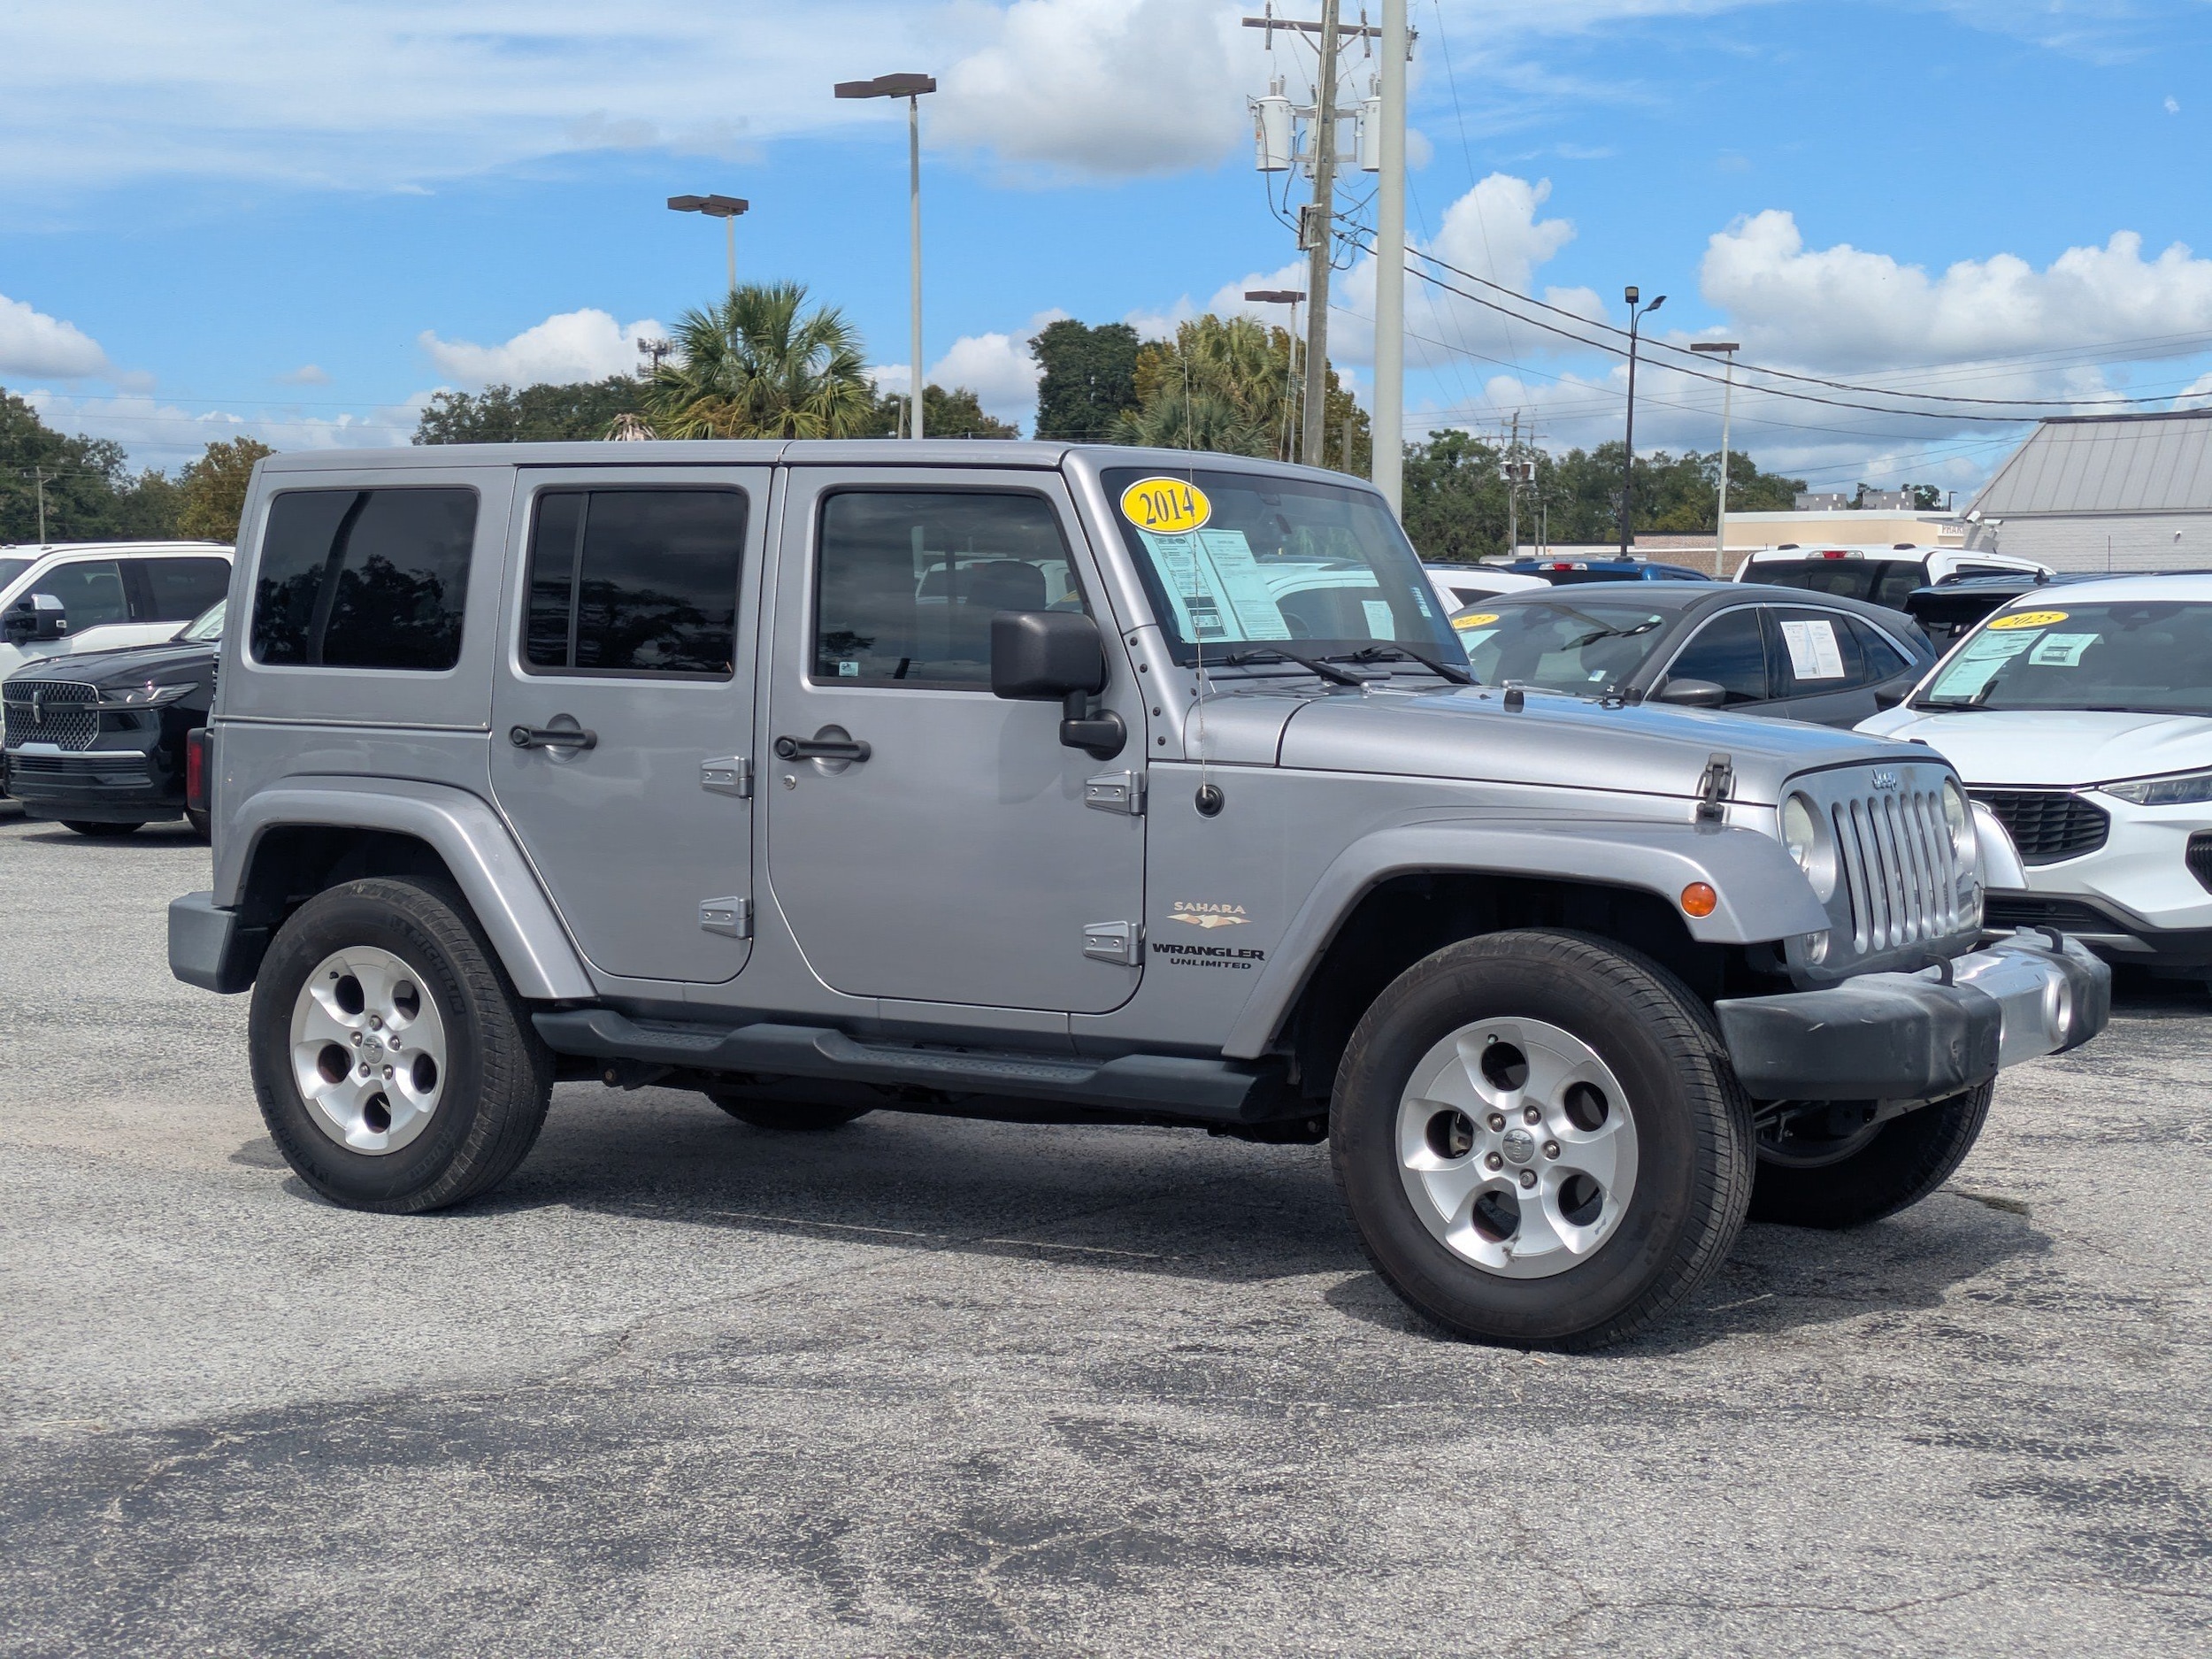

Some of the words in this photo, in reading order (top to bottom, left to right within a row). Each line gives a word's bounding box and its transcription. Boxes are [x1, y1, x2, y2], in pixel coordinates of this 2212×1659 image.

[1140, 487, 1194, 525] 2014
[2001, 613, 2059, 627] 2025
[1871, 769, 1897, 792] Jeep
[1173, 901, 1247, 915] SAHARA
[1152, 942, 1265, 962] WRANGLER
[408, 929, 466, 1016] MICHELIN
[1170, 957, 1252, 971] UNLIMITED
